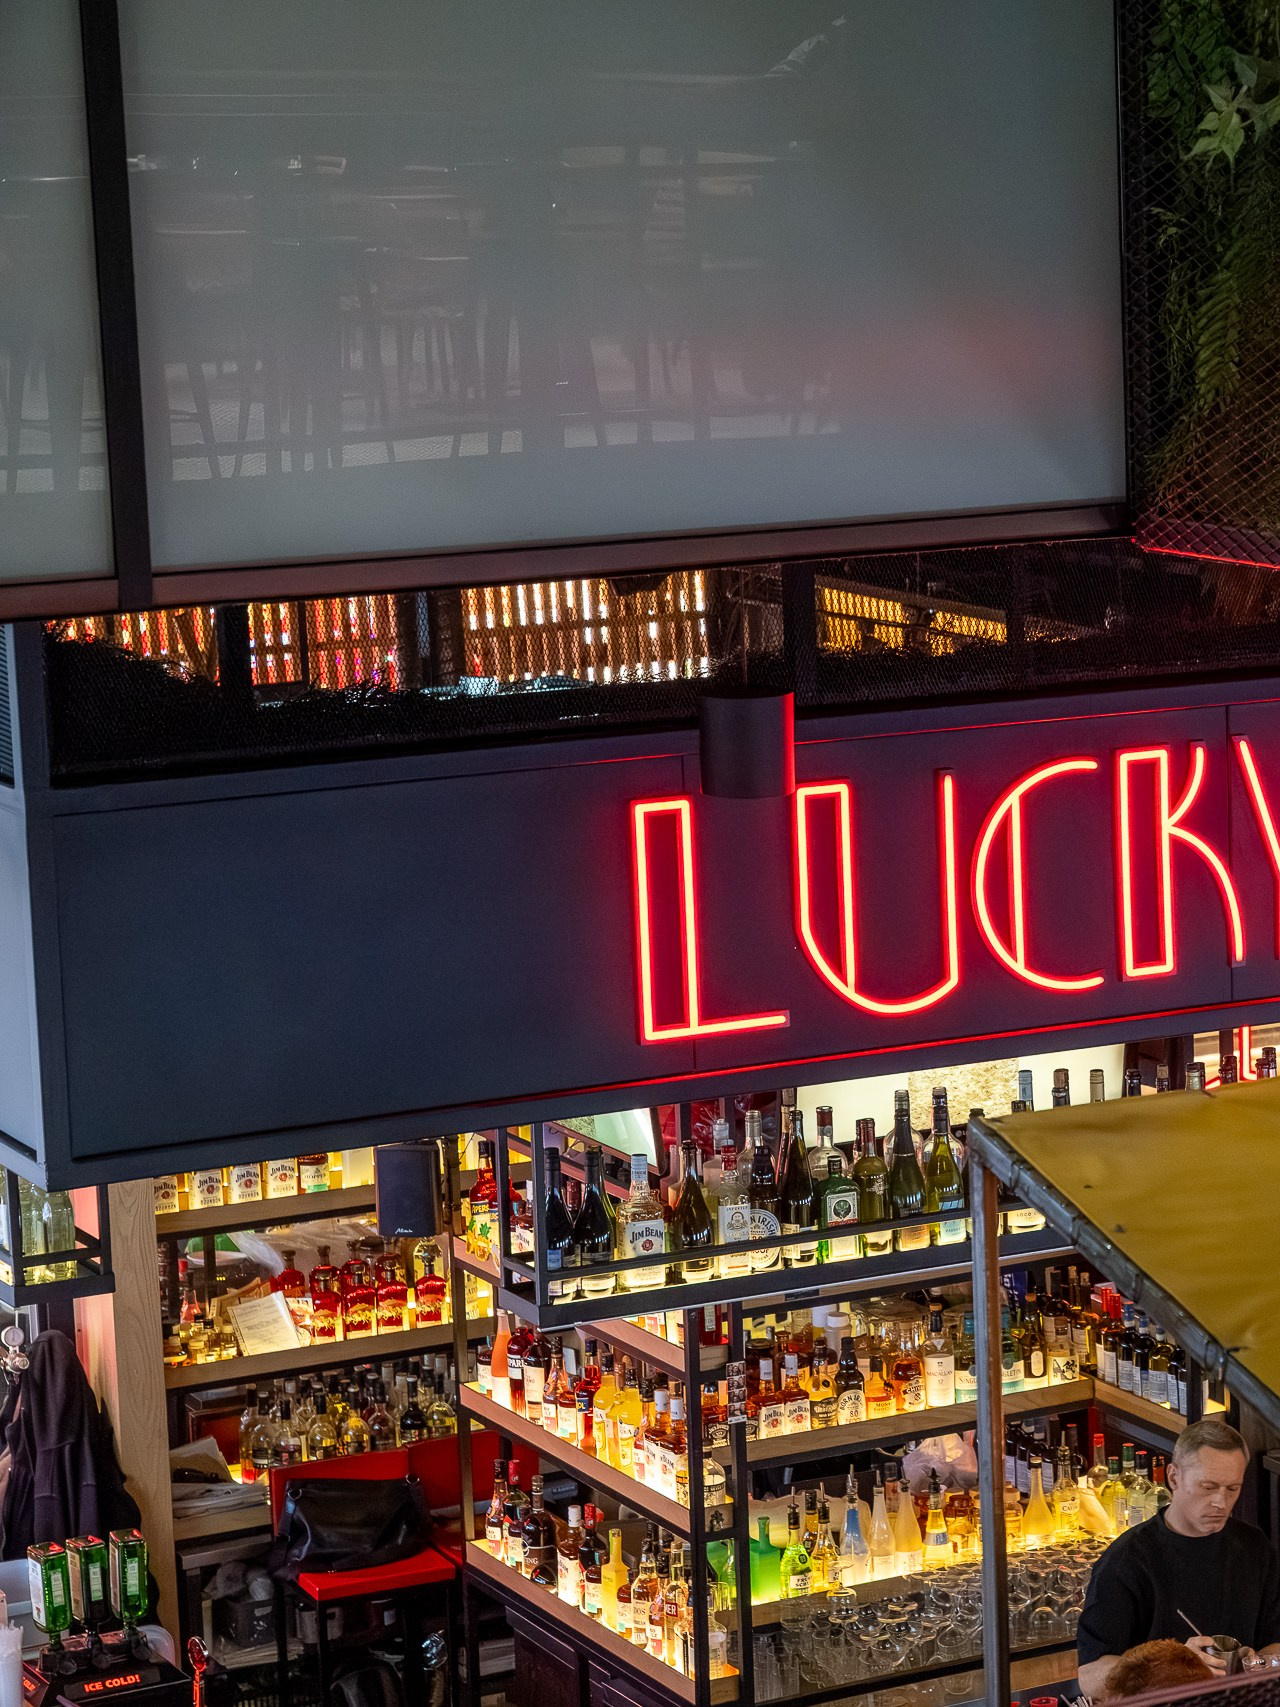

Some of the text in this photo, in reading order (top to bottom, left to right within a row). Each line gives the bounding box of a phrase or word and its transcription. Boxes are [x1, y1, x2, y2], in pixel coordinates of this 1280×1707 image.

[758, 1215, 776, 1236] IRISH
[630, 1227, 664, 1243] JIM BEAM
[84, 1674, 140, 1692] ICE COLD!
